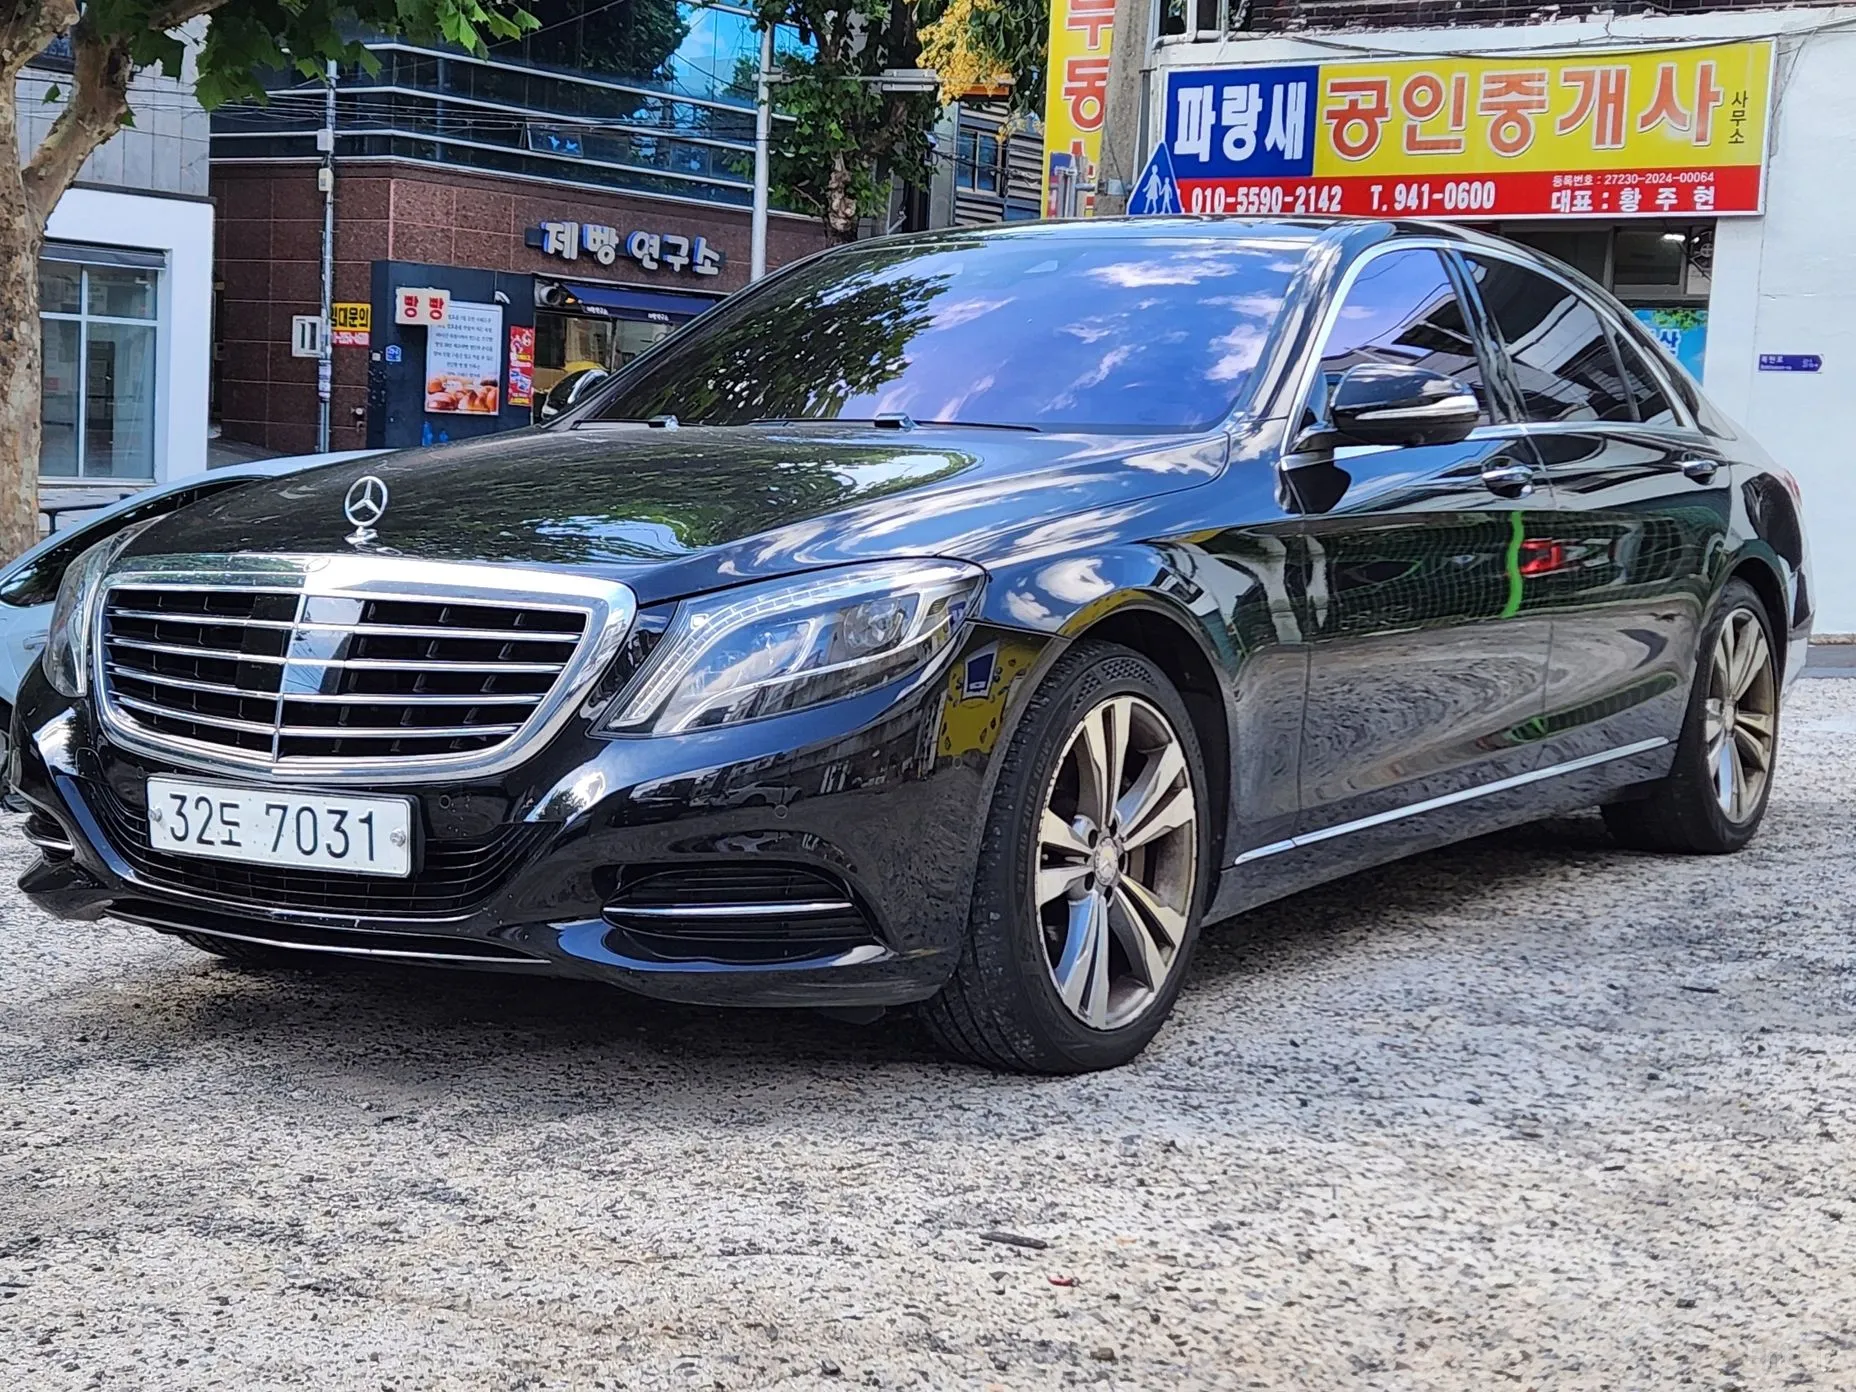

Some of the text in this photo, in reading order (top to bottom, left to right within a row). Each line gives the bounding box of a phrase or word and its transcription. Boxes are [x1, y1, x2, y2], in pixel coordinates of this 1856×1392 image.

[1174, 60, 1749, 162] 파랑새 공인중개사 사무소
[1192, 185, 1342, 214] 010-5590-2142
[1394, 180, 1496, 211] 941-0600
[1551, 189, 1593, 213] 대표
[1604, 172, 1715, 186] 27230-2024-00064
[540, 221, 720, 276] 제빵 연구소
[169, 792, 376, 862] 32도 7031
